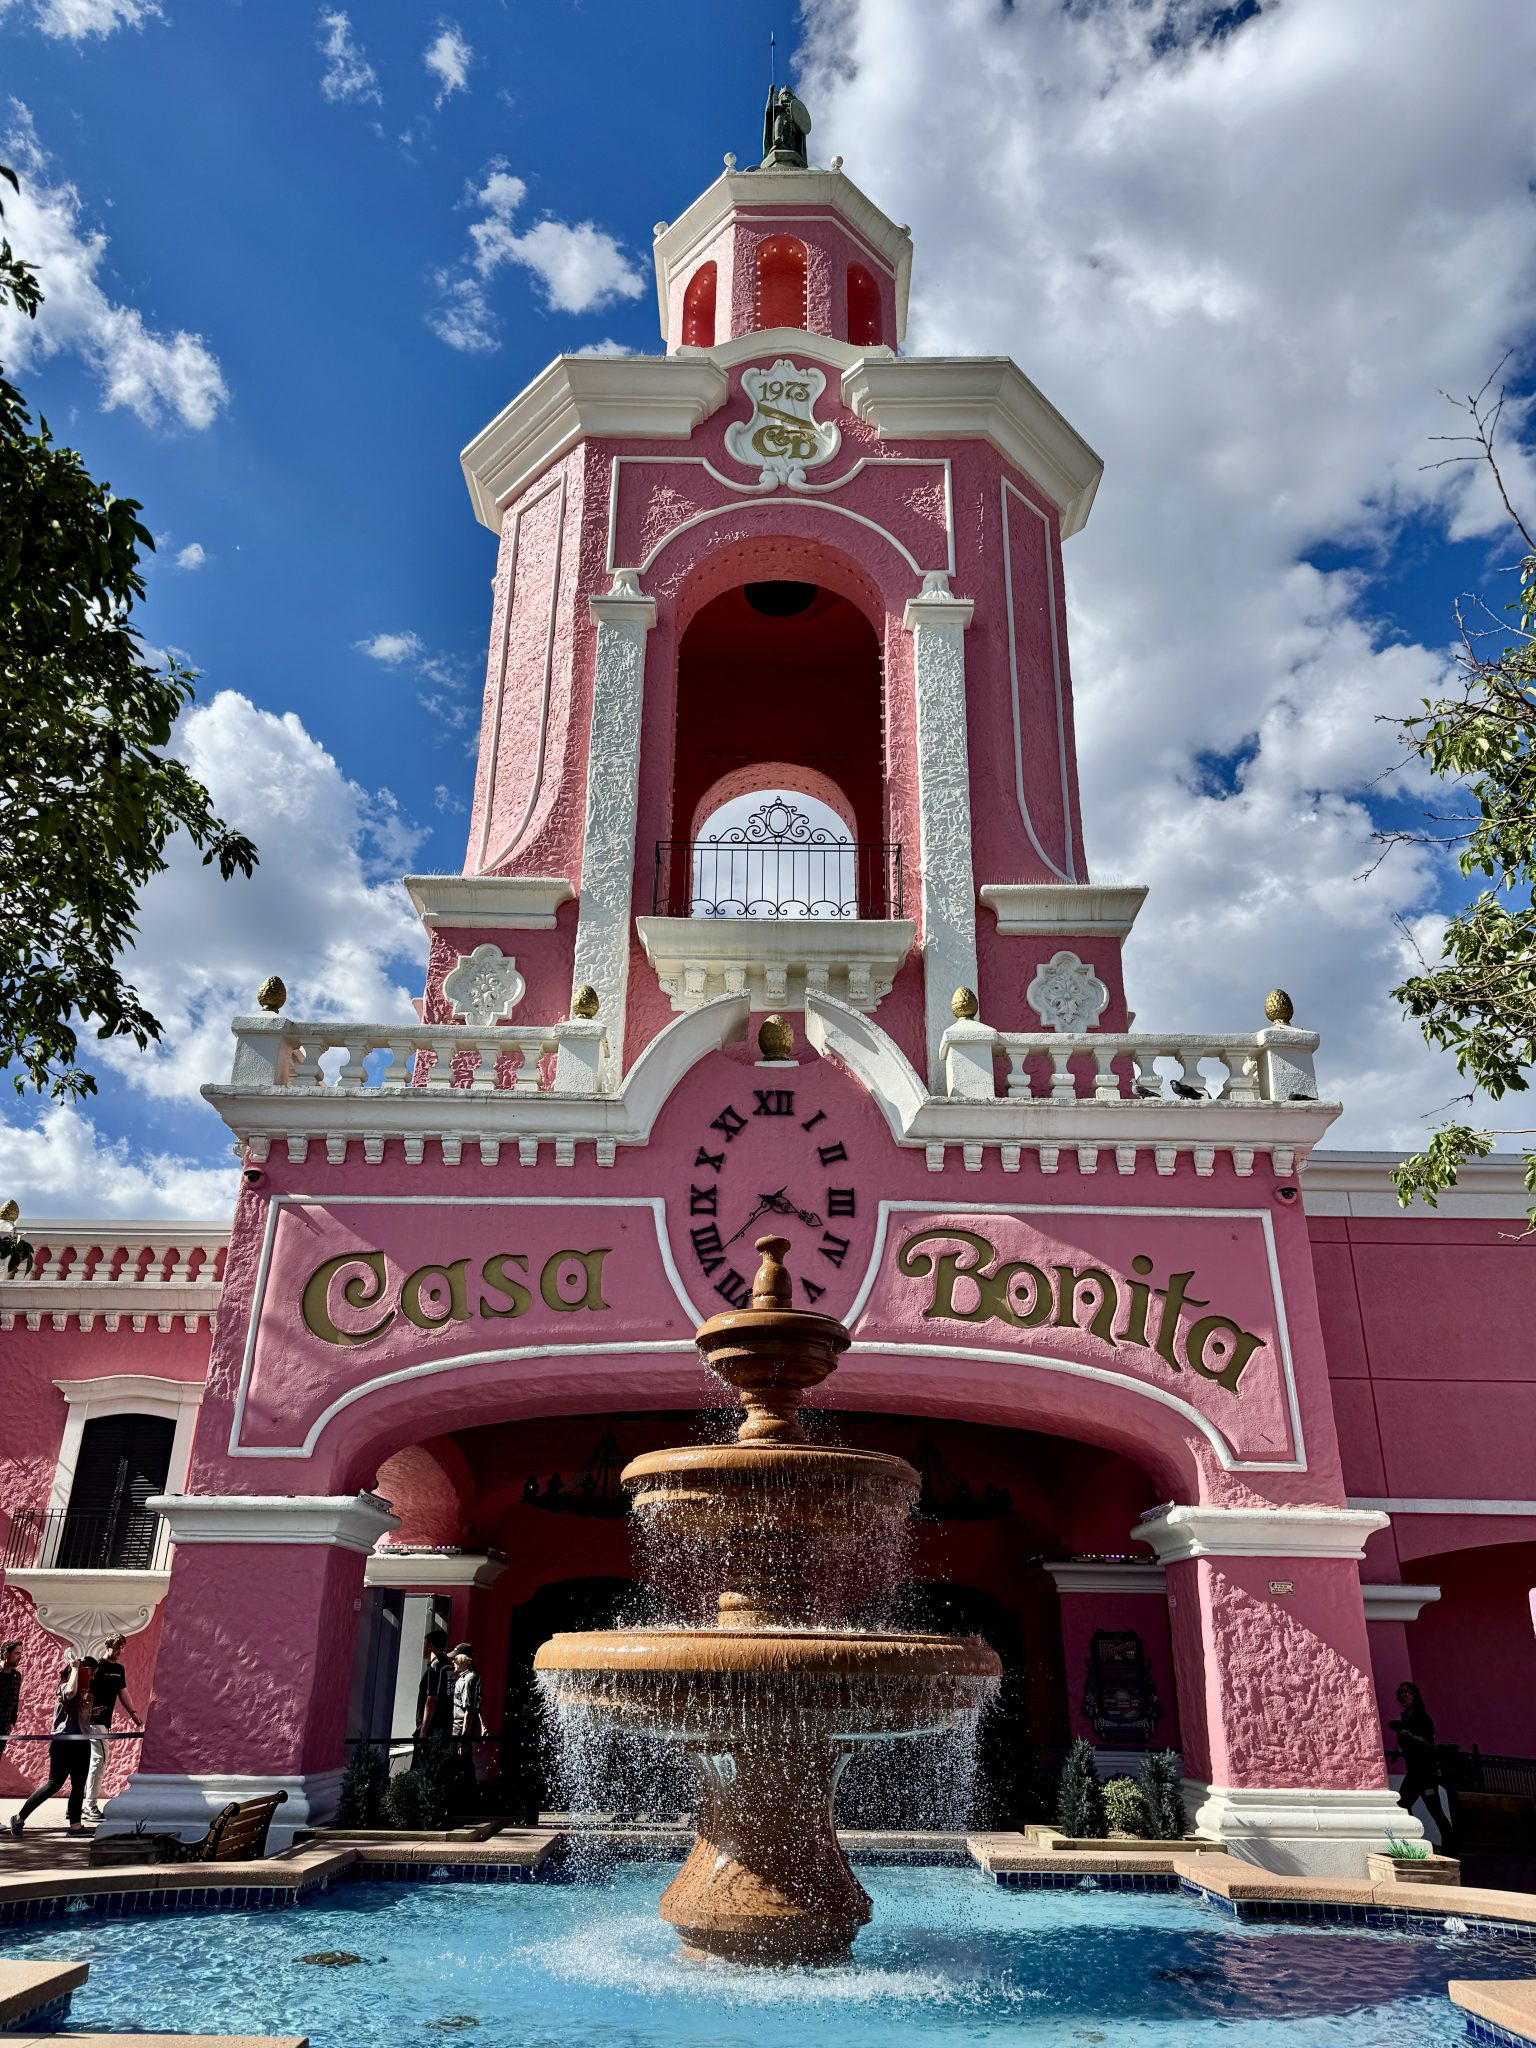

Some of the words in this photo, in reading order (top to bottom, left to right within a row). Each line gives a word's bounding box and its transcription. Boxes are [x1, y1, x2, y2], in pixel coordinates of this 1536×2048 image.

[758, 381, 811, 402] 1973
[753, 1090, 795, 1116] XII
[710, 1105, 748, 1142] XI
[801, 1109, 827, 1132] I
[694, 1146, 725, 1173] X
[817, 1141, 848, 1167] II
[690, 1184, 717, 1217] IX
[828, 1186, 855, 1218] III
[690, 1222, 727, 1277] VIII
[818, 1230, 849, 1268] IV
[800, 1276, 826, 1304] V
[301, 1249, 613, 1347] Casa
[899, 1228, 1268, 1396] Bonita
